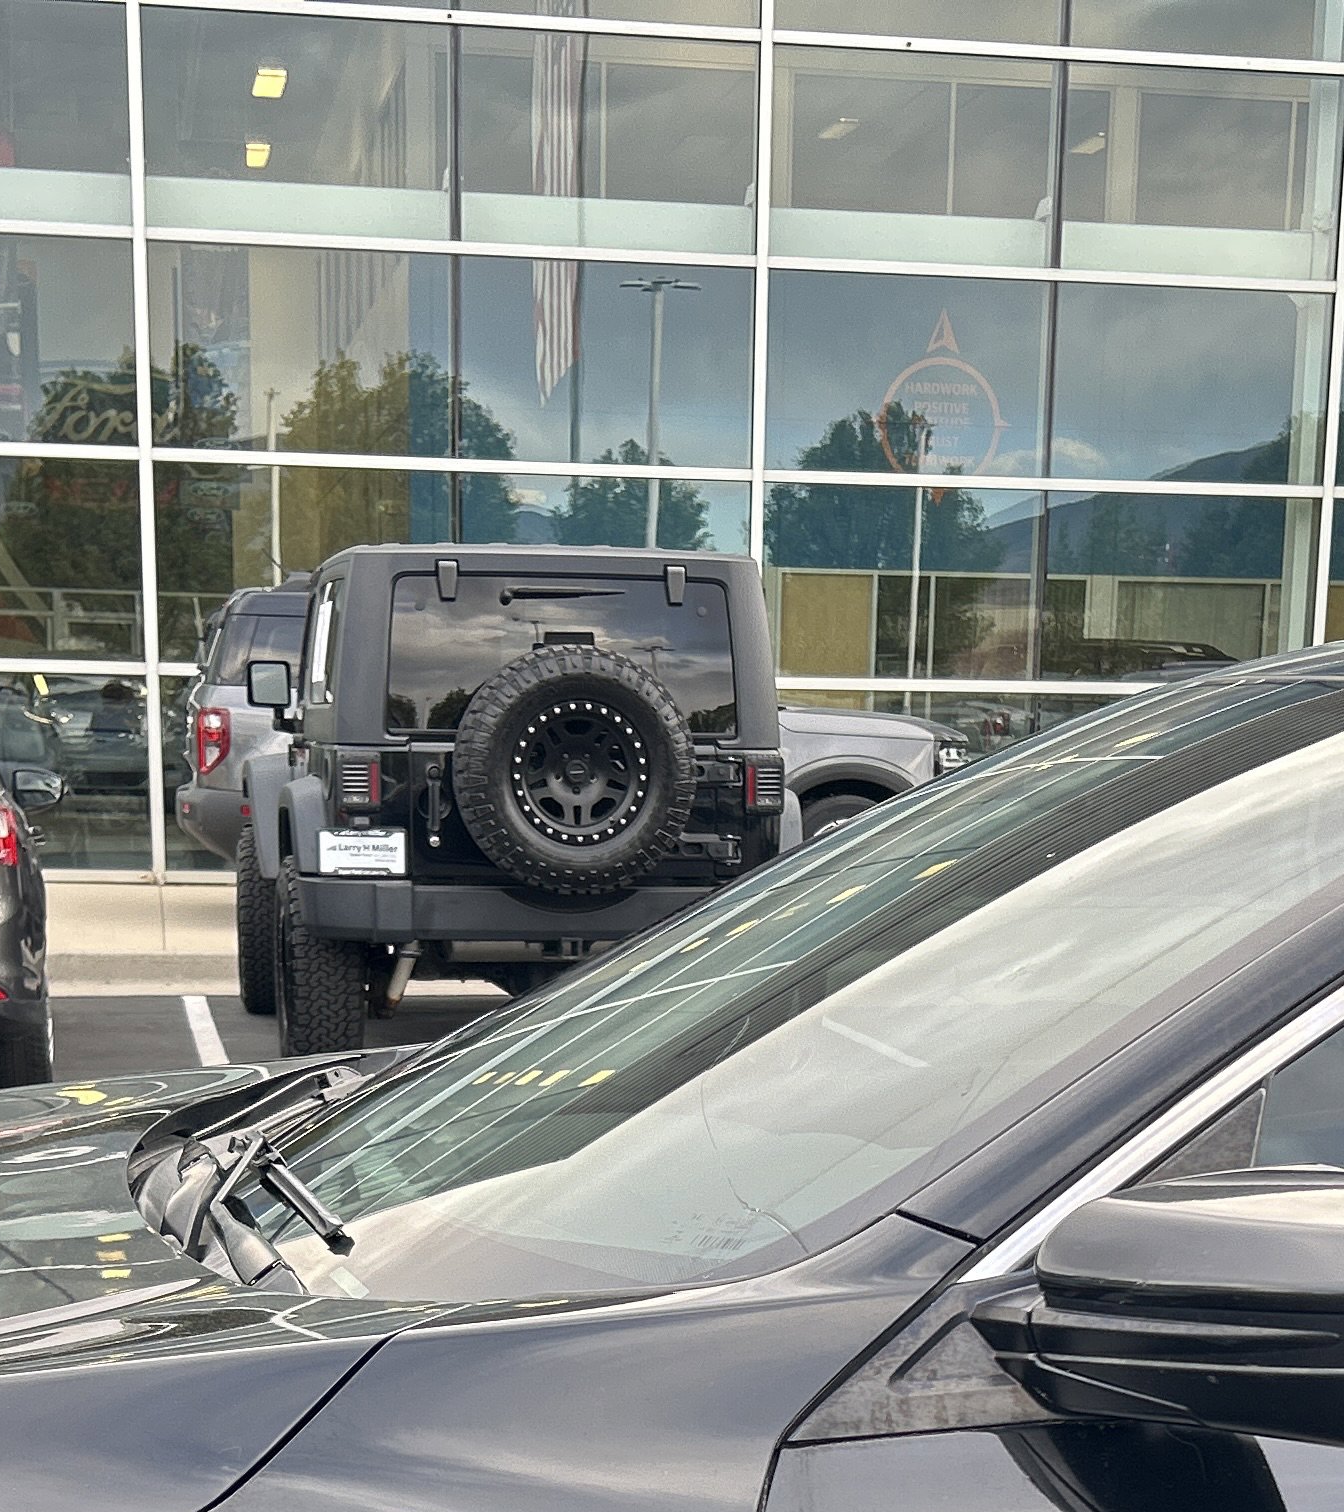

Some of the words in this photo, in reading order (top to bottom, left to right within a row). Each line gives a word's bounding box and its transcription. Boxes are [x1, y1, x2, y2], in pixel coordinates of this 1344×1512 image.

[906, 382, 977, 396] HARDWORK
[913, 400, 970, 415] POSITIVE
[338, 843, 362, 852] Larry
[371, 843, 398, 853] Miller
